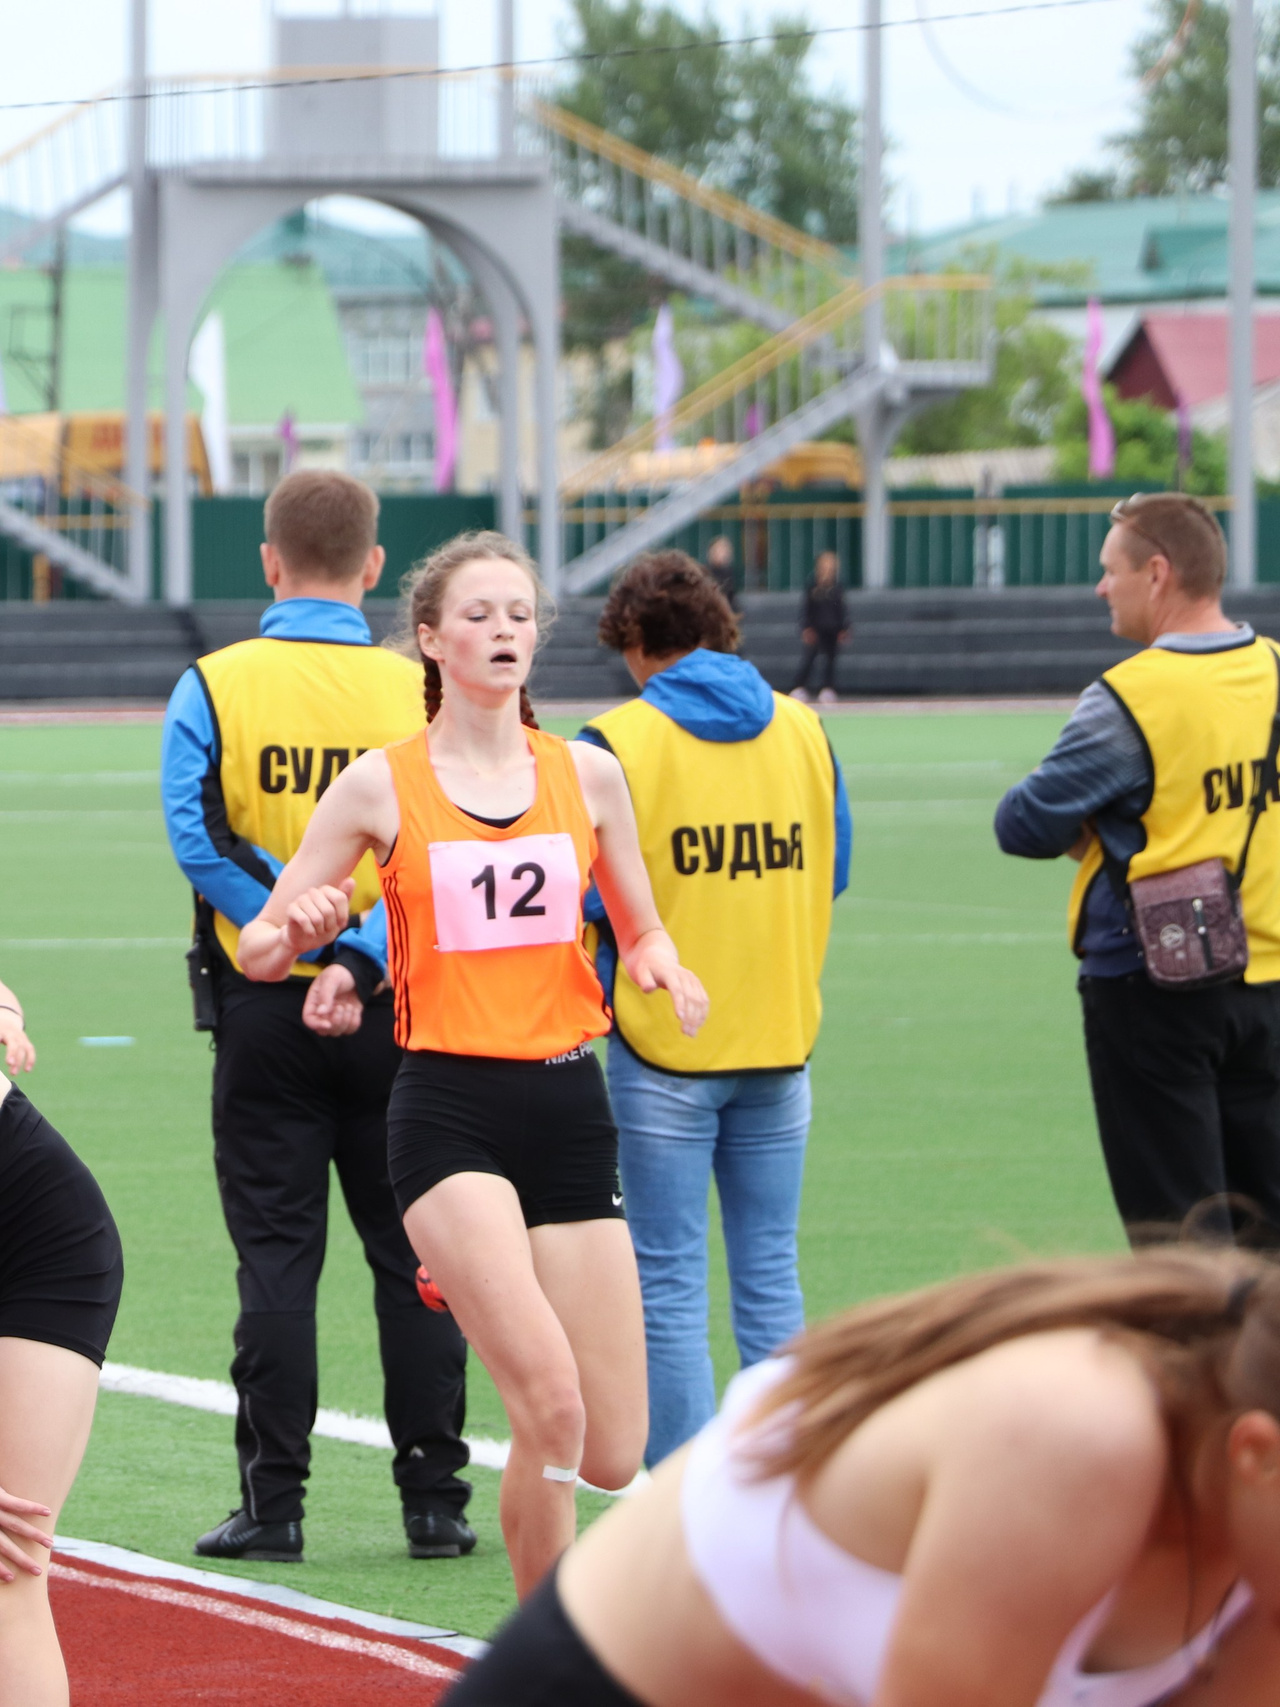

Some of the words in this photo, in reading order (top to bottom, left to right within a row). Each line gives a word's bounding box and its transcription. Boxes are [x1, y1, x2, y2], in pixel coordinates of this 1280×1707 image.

[260, 745, 369, 803] СУД
[671, 822, 803, 880] СУДЬЯ
[471, 862, 546, 920] 12
